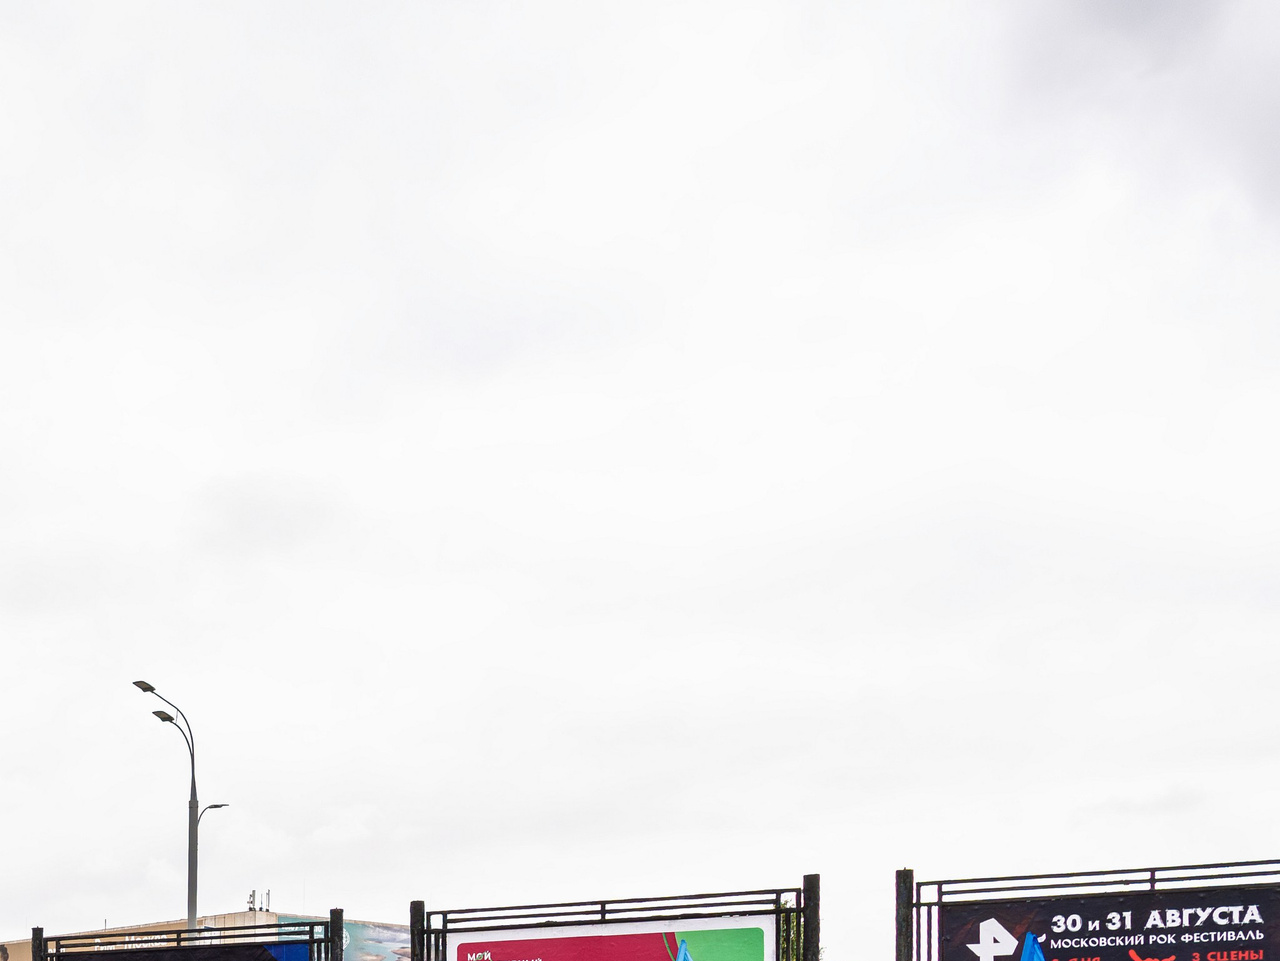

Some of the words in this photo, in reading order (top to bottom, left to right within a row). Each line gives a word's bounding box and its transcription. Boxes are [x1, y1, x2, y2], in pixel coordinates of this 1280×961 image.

[1051, 914, 1082, 933] 30
[1088, 920, 1100, 931] и
[1106, 911, 1132, 931] 31
[1144, 905, 1264, 930] АВГУСТА
[1050, 935, 1144, 949] МОСКОВСКИЙ
[1149, 934, 1176, 944] РОК
[1181, 930, 1264, 943] ФЕСТИВАЛЬ
[468, 951, 491, 961] МОЙ
[1207, 950, 1264, 961] СЦЕНЫ
